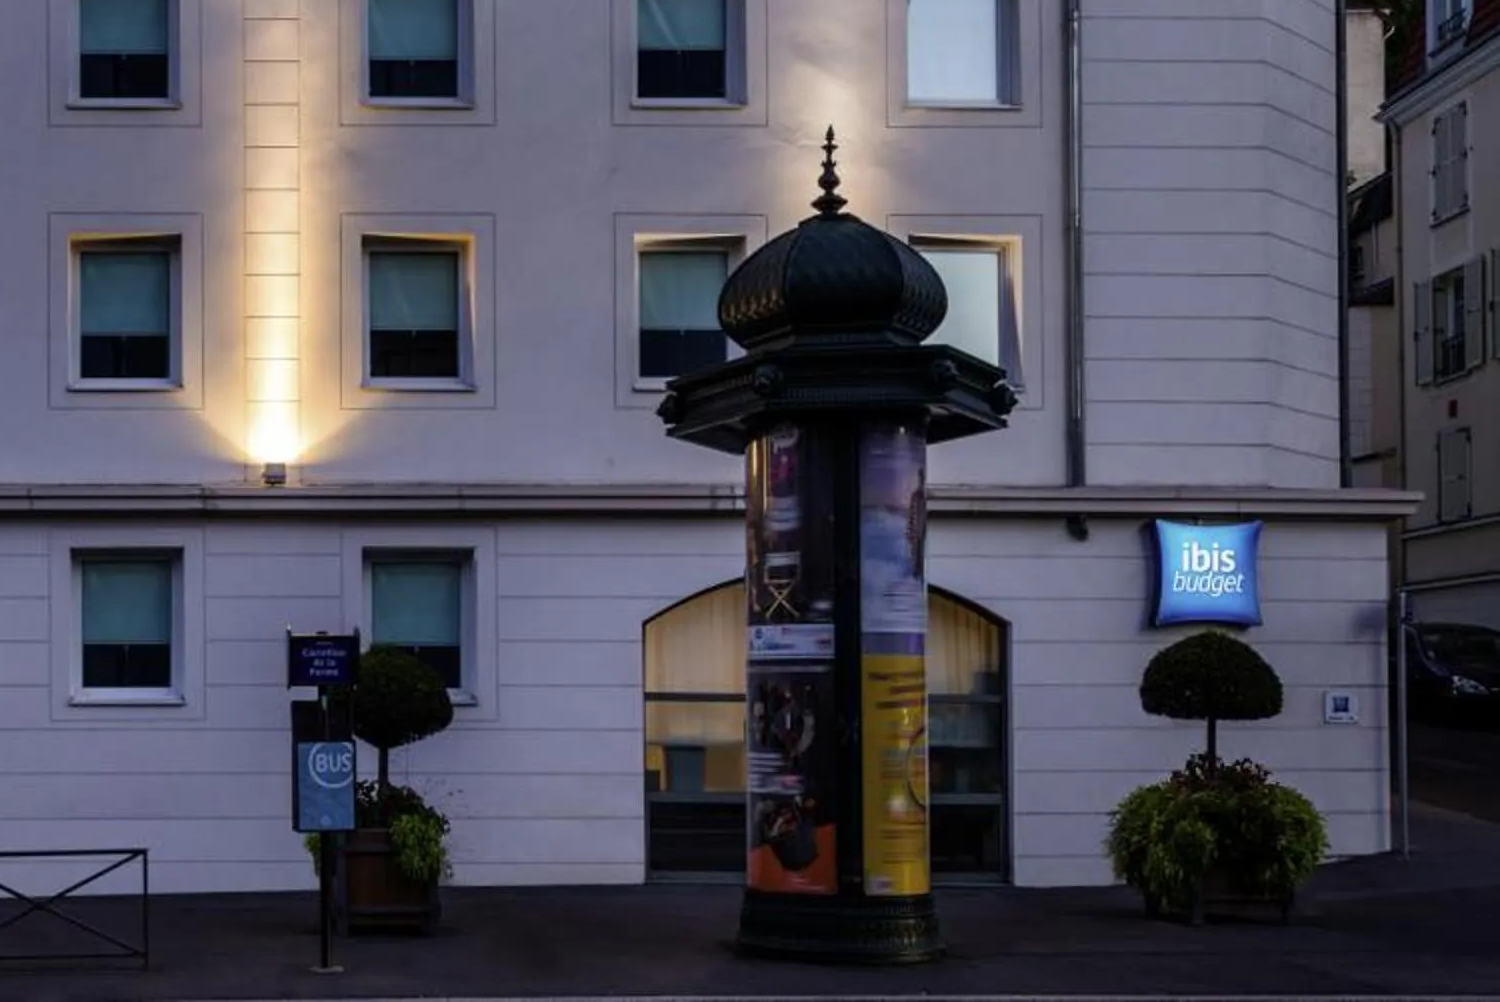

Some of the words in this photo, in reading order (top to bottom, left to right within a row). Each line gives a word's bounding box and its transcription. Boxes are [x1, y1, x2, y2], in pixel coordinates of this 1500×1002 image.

[1181, 541, 1236, 573] ibis
[1172, 571, 1245, 597] budget
[315, 752, 353, 774] BUS
